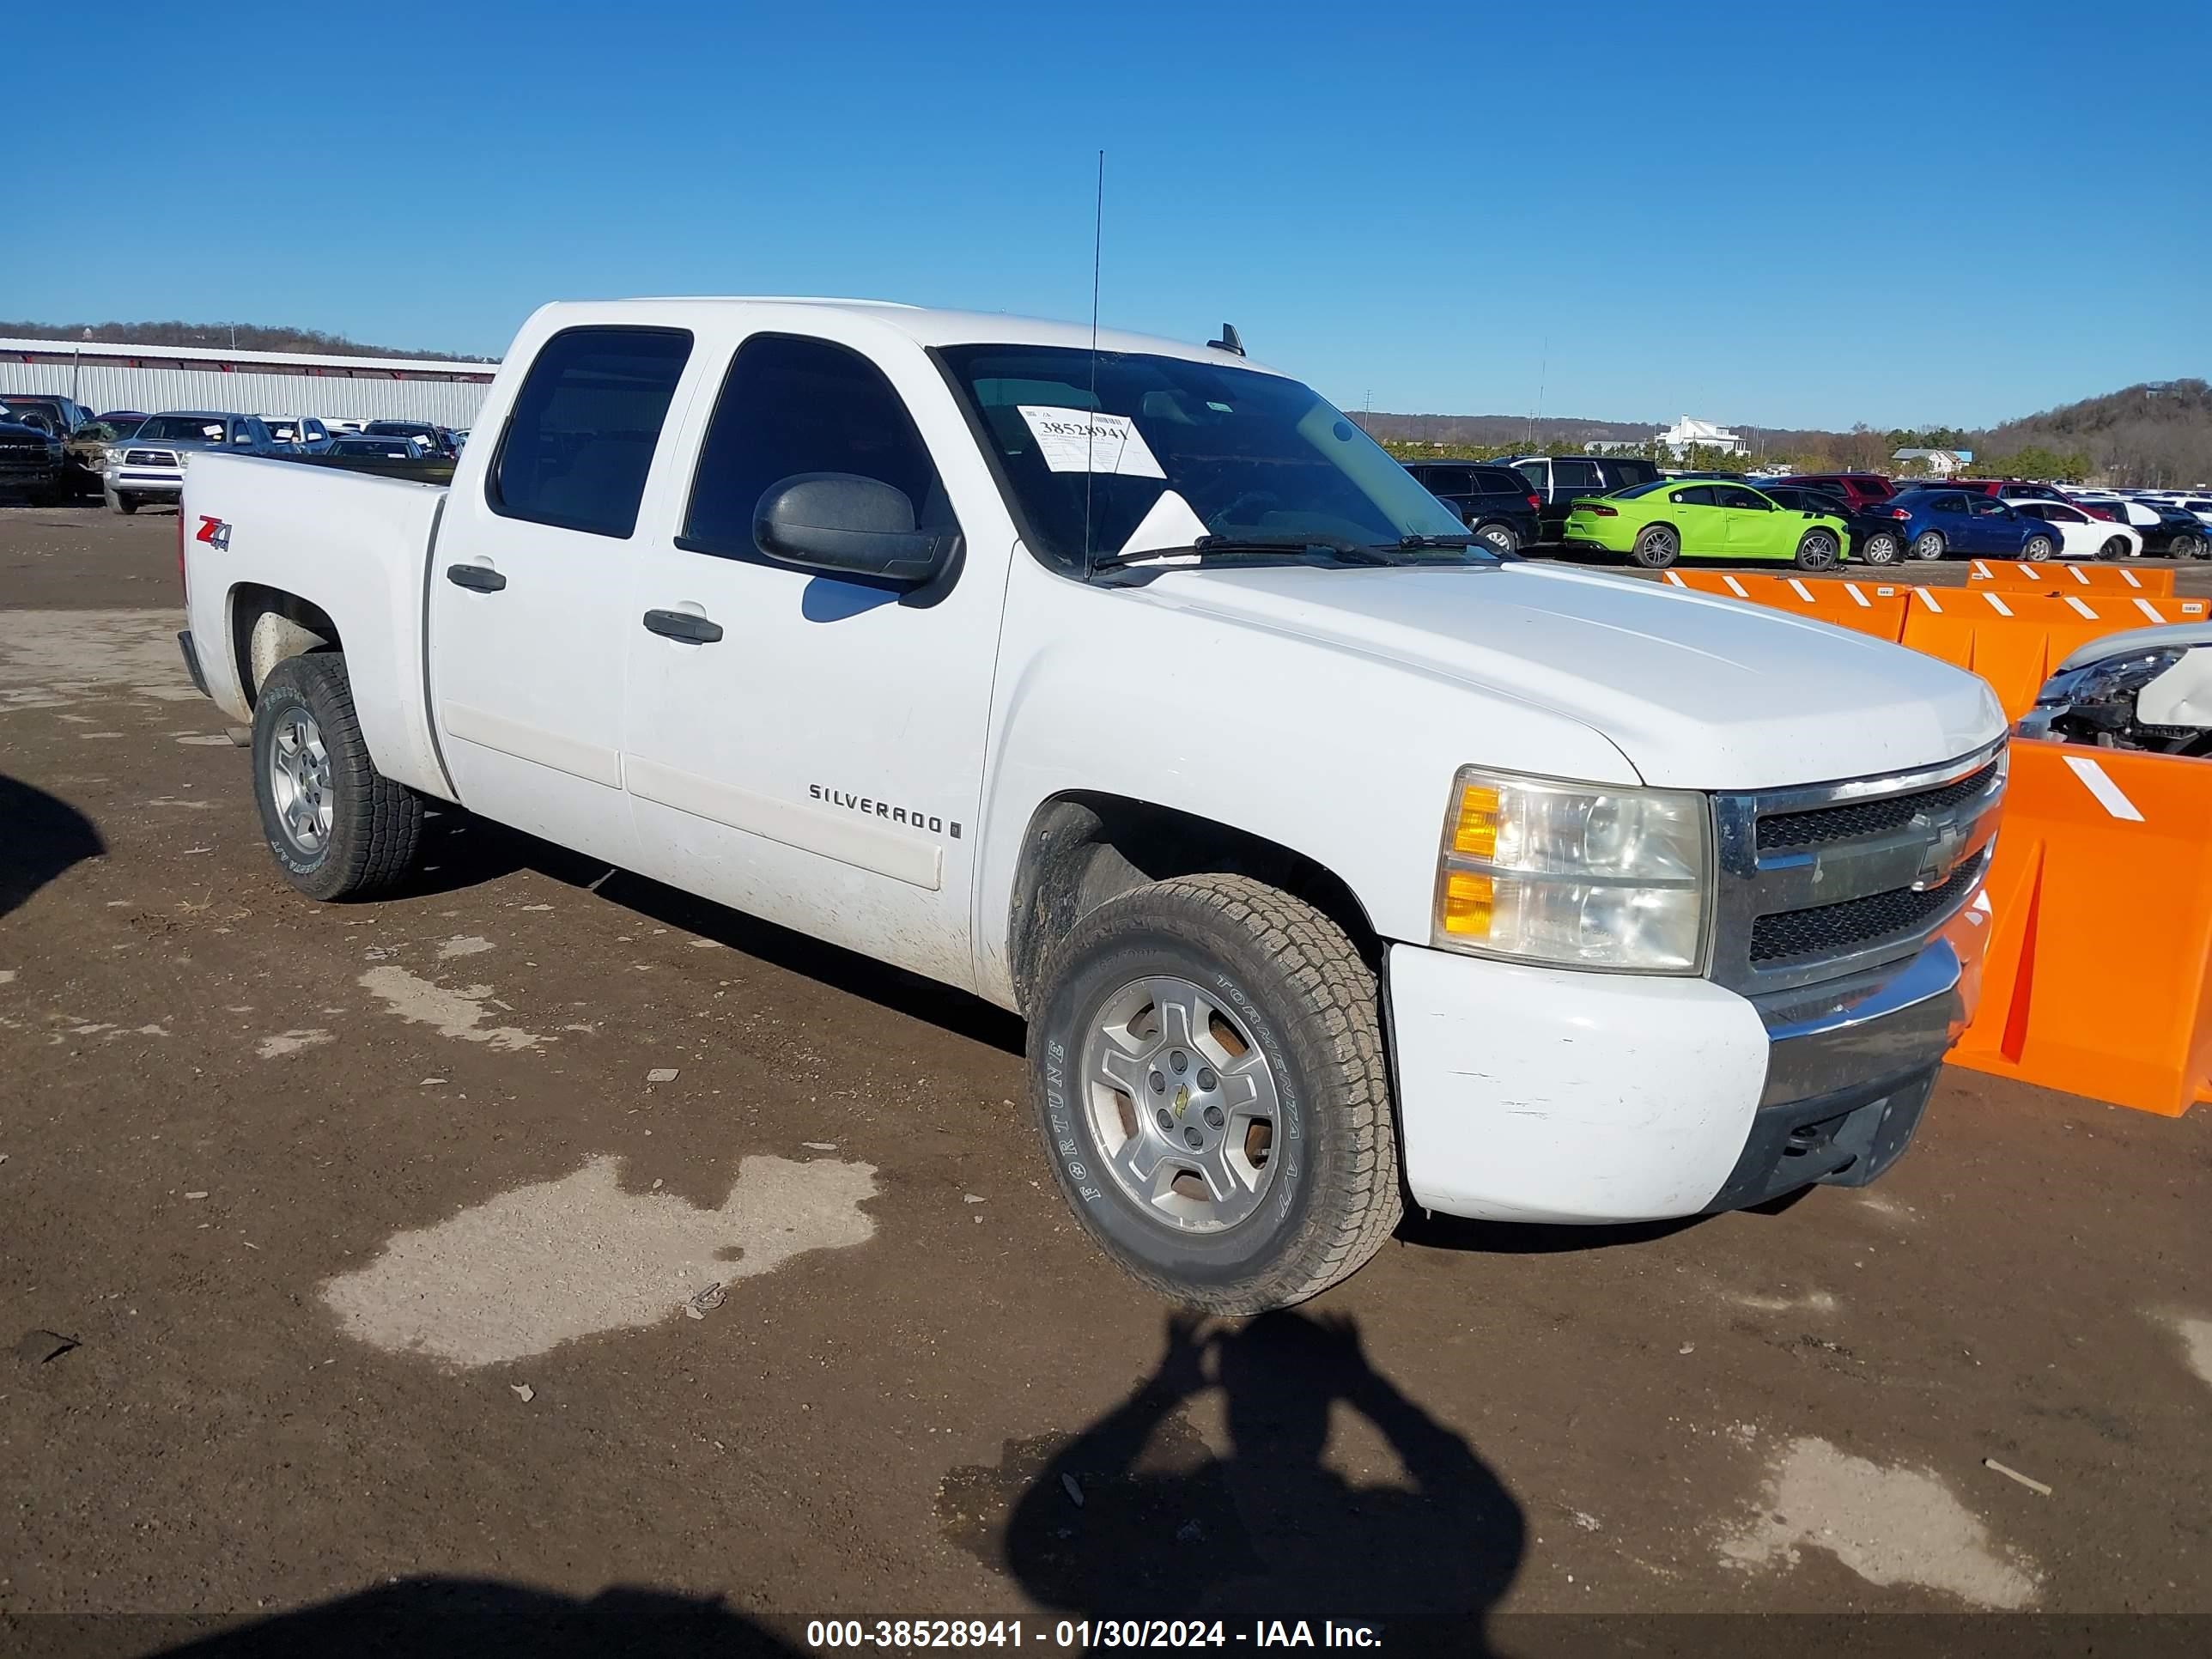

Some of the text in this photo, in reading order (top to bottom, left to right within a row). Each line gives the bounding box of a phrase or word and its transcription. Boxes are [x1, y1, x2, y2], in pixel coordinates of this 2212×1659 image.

[197, 515, 232, 544] Z71
[809, 784, 942, 834] SILVERADO
[1046, 1039, 1103, 1202] FORTUNE
[1218, 975, 1300, 1218] TORMENTA A/T
